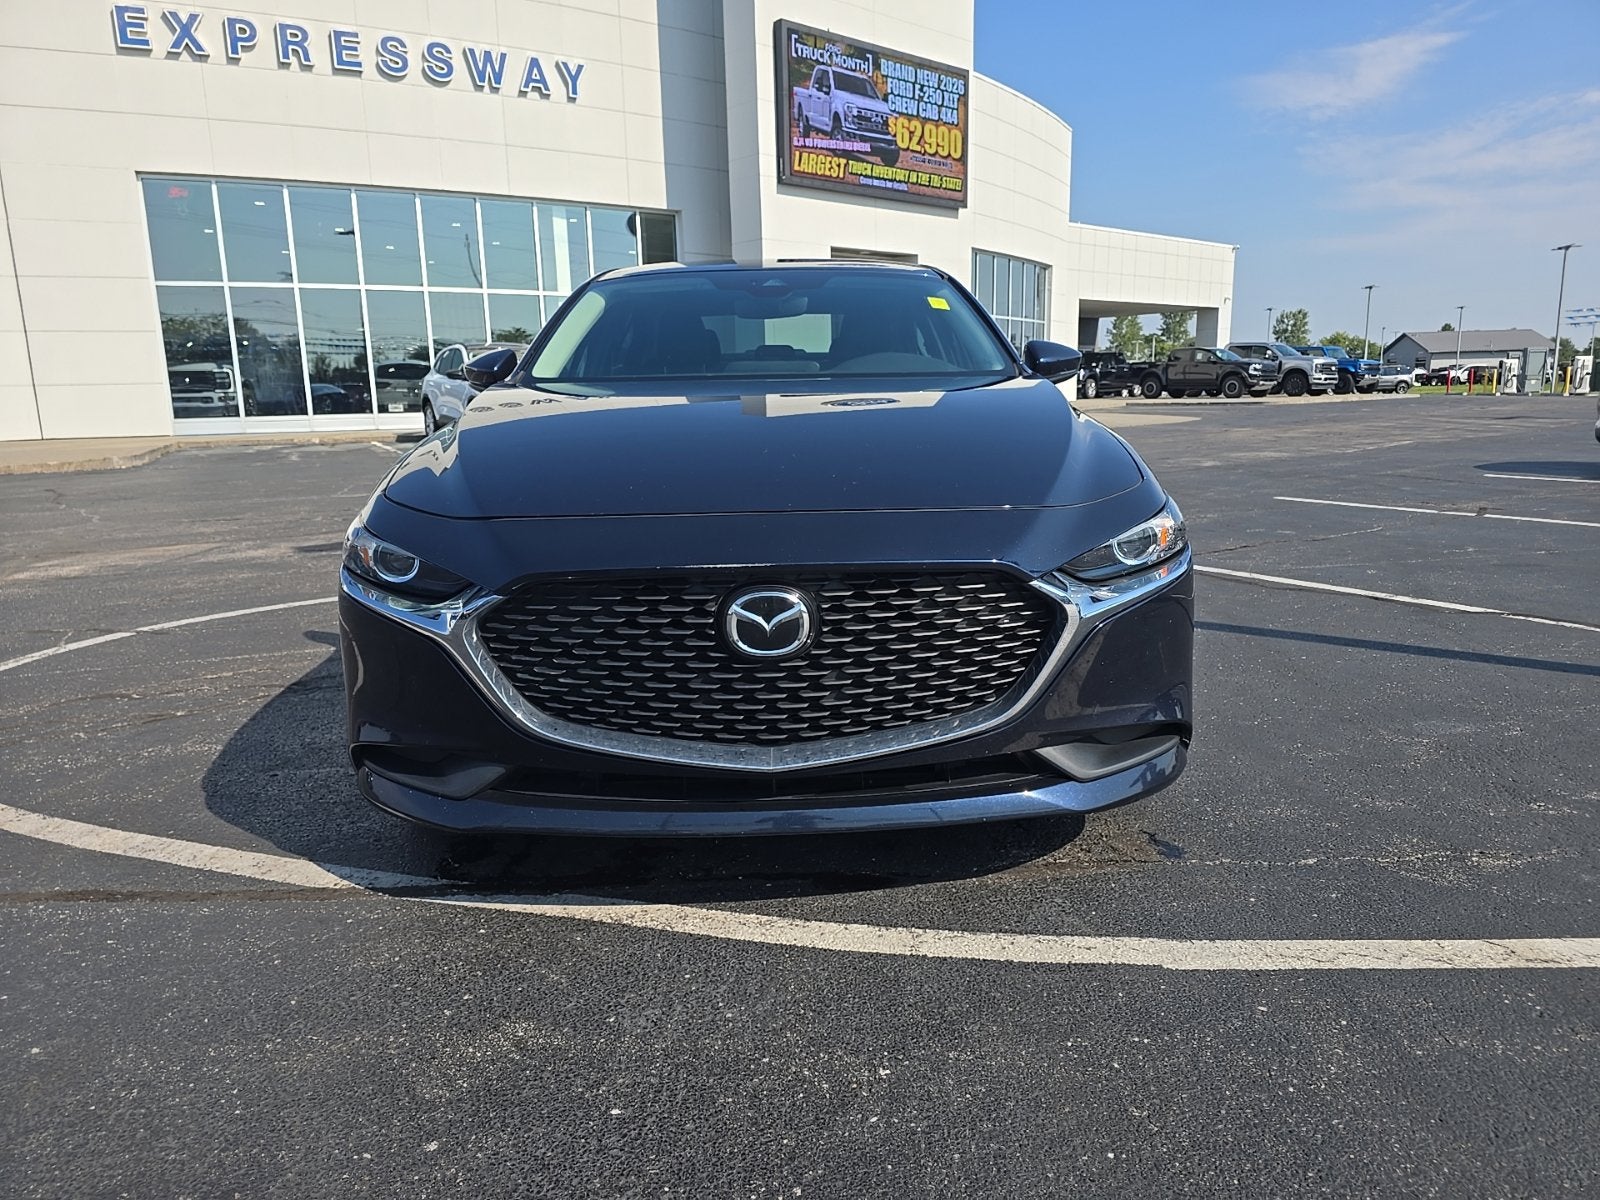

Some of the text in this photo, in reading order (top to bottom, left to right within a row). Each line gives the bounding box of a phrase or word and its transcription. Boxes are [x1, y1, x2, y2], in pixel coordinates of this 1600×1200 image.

[114, 4, 586, 99] EXPRESSWAY
[881, 58, 965, 95] BRAND NEW 2026
[887, 77, 960, 109] FORD F-250 XLT
[888, 94, 958, 125] CREW CAB 4X4
[888, 117, 963, 159] $62,990
[794, 150, 848, 178] LARGEST
[848, 160, 873, 176] TRUCK
